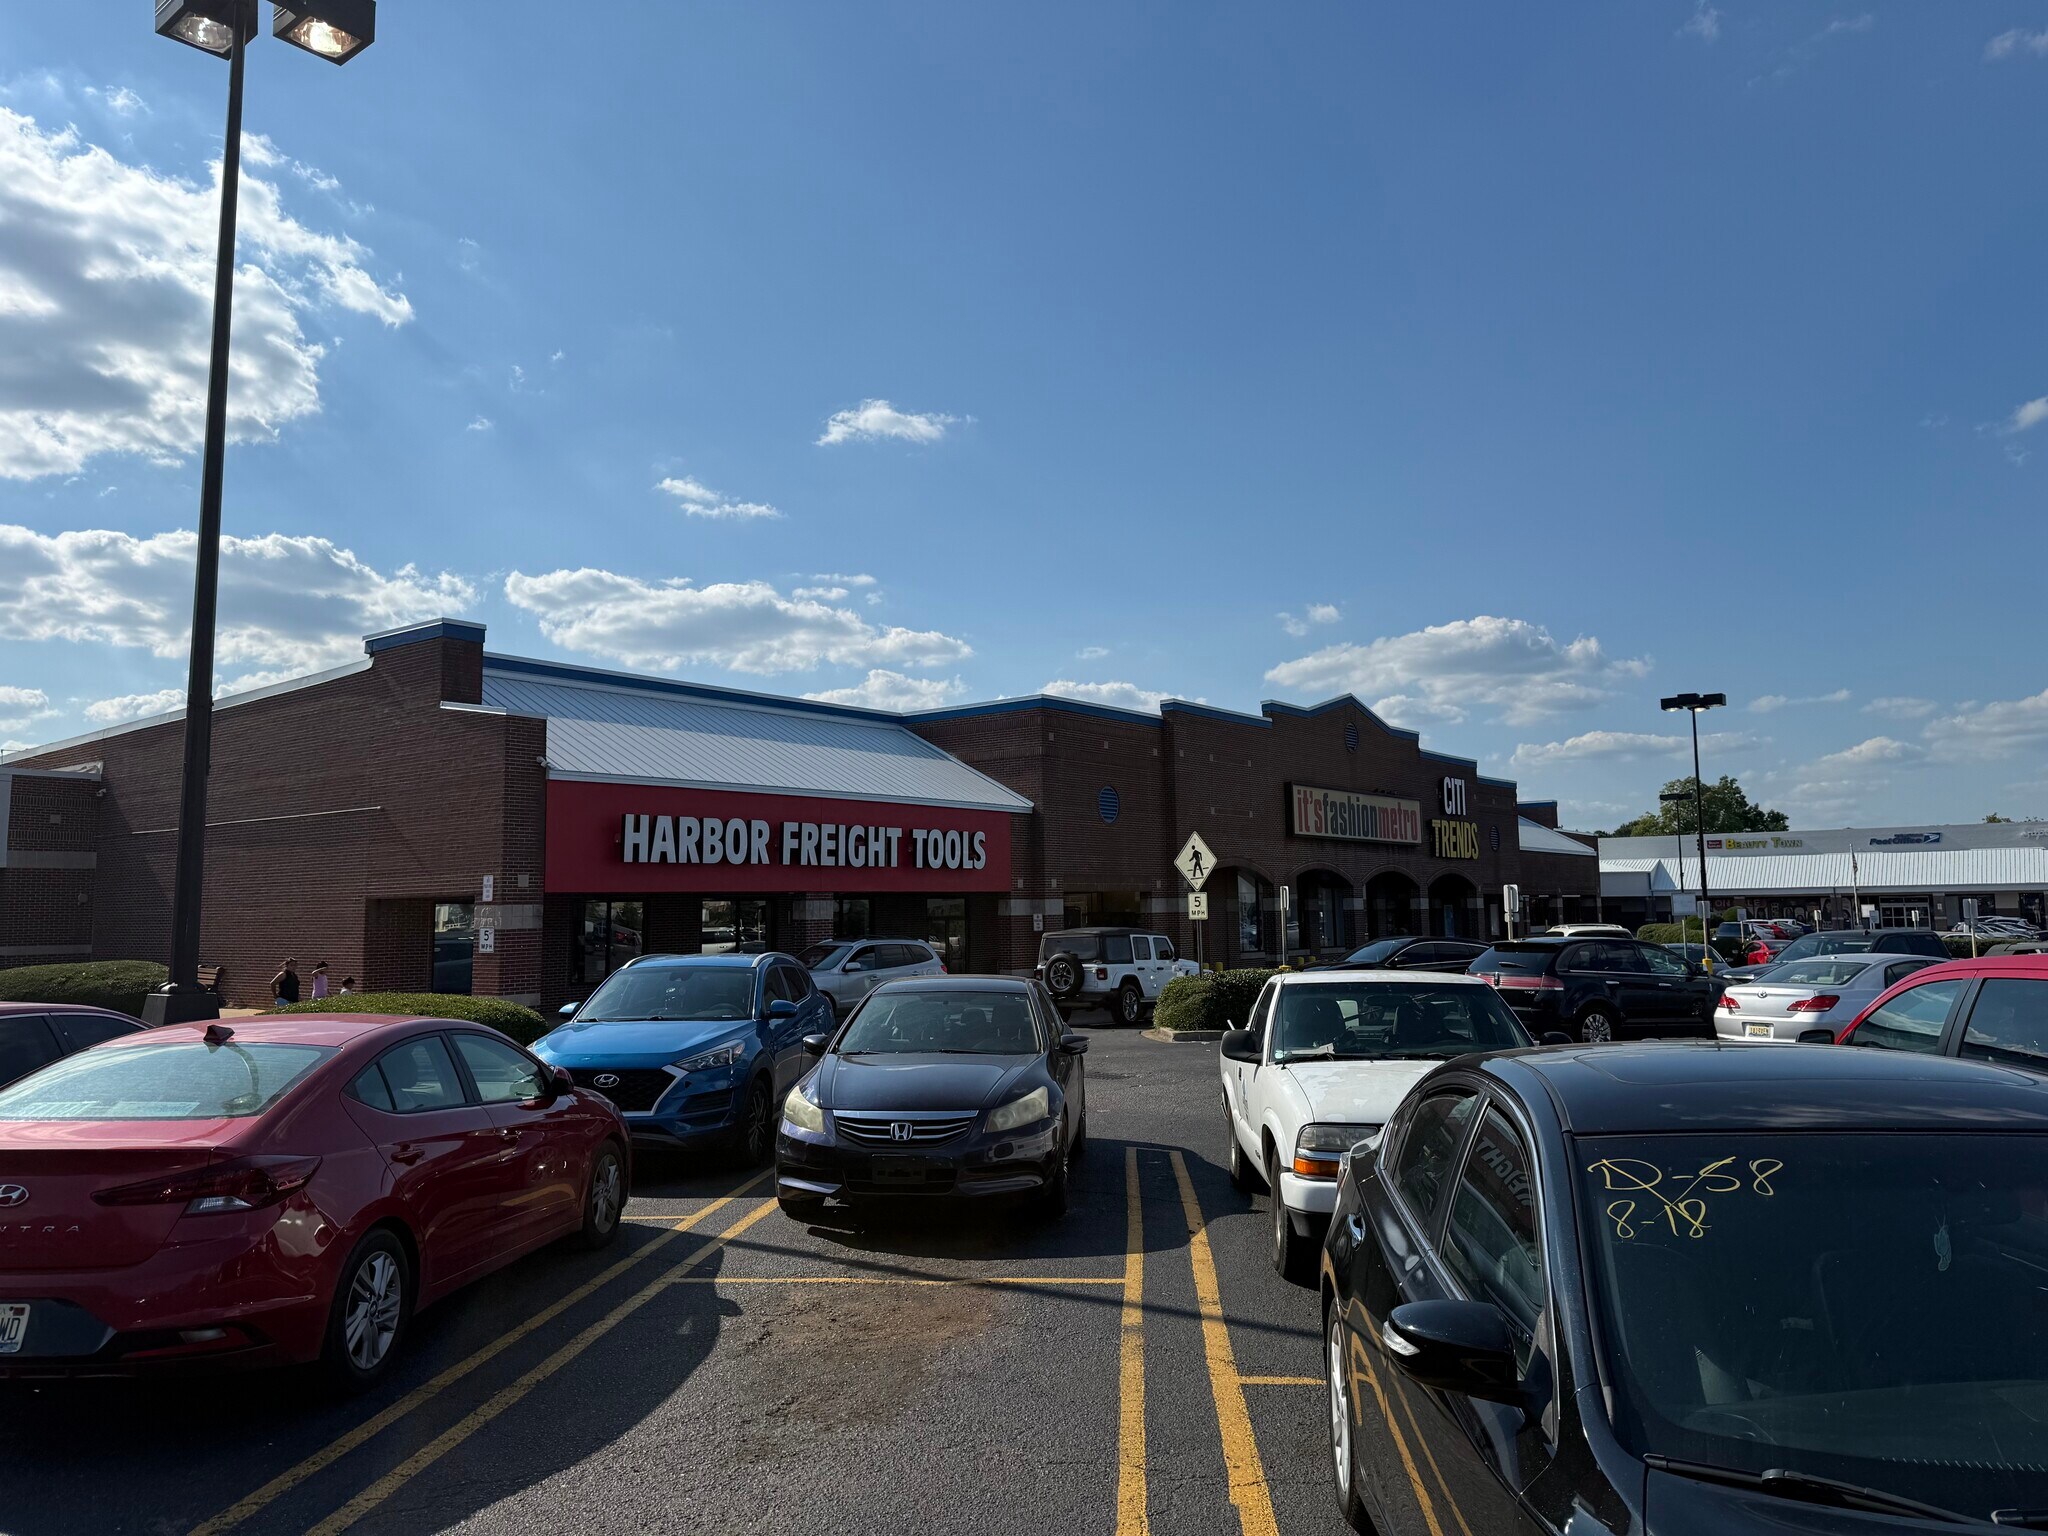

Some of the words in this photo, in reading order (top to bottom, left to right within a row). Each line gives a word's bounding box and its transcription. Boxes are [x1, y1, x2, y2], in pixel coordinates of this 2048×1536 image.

[1443, 776, 1466, 816] CITI
[623, 813, 770, 865] HARBOR
[782, 821, 902, 869] FREIGHT
[912, 828, 986, 870] TOOLS
[1431, 819, 1479, 860] TRENDS
[1194, 896, 1201, 908] 5
[483, 930, 490, 942] 5
